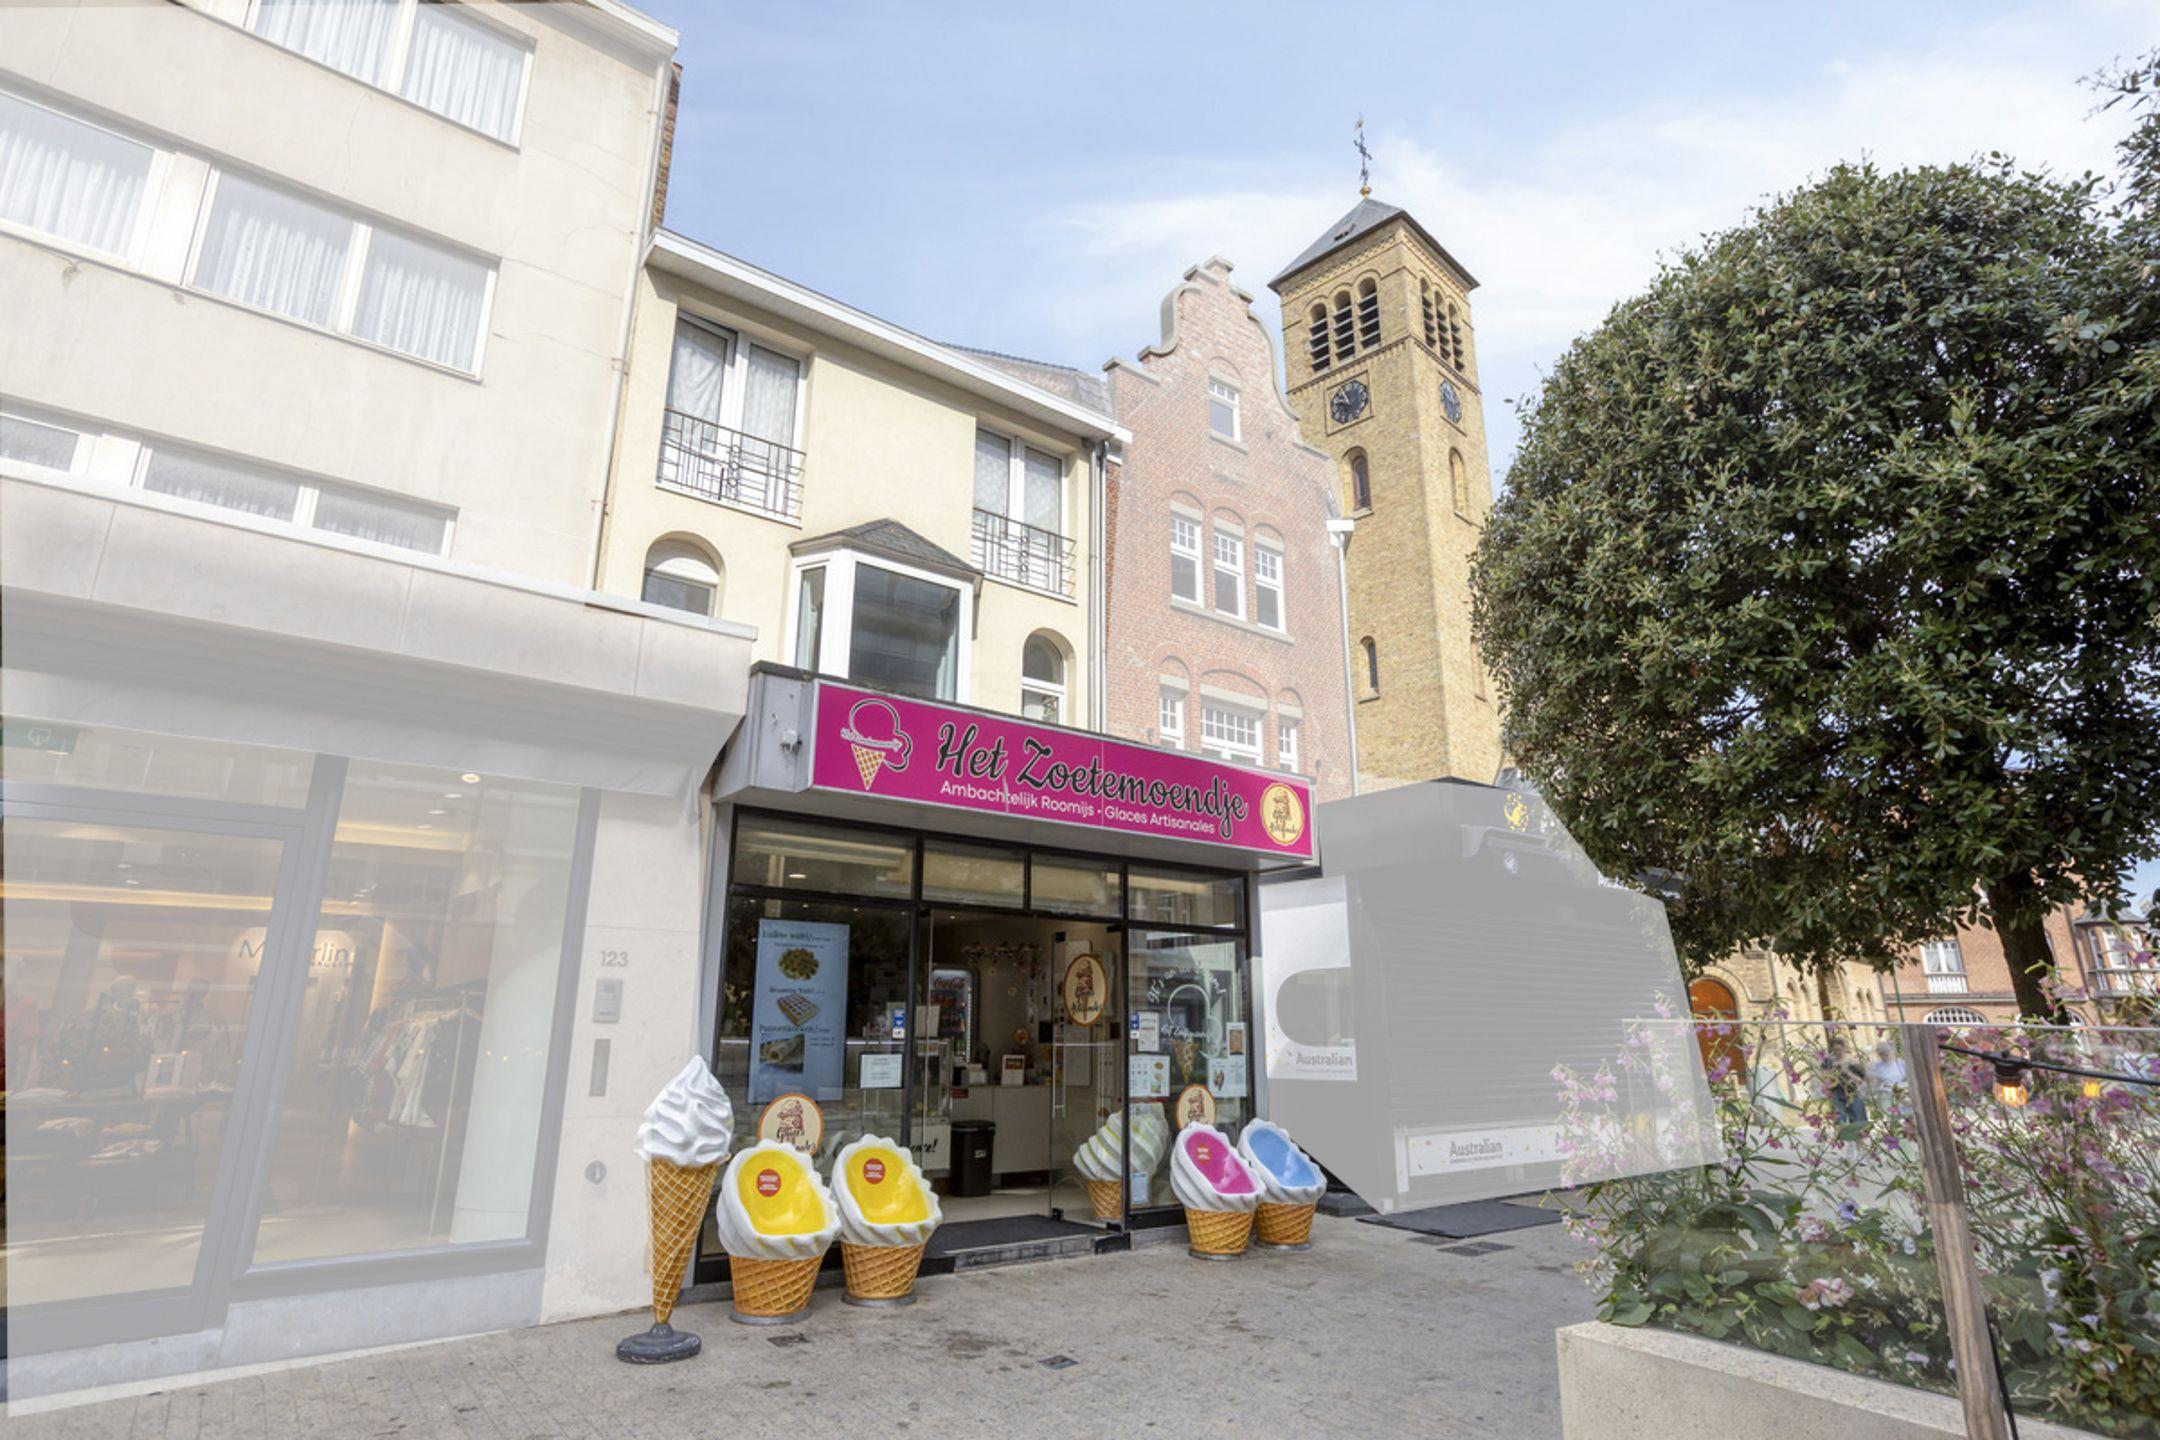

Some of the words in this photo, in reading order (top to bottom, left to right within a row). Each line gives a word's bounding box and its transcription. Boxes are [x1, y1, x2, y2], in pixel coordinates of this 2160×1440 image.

[937, 722, 1008, 780] Het
[1017, 736, 1248, 839] Zoetemoendje
[940, 780, 1038, 809] Ambachtelijk
[1041, 796, 1094, 818] Roomijs
[1105, 805, 1148, 824] Glaces
[1150, 810, 1216, 834] Artisanales
[600, 950, 629, 967] 123
[1295, 1052, 1353, 1066] Australian
[1450, 1138, 1504, 1157] Australian
